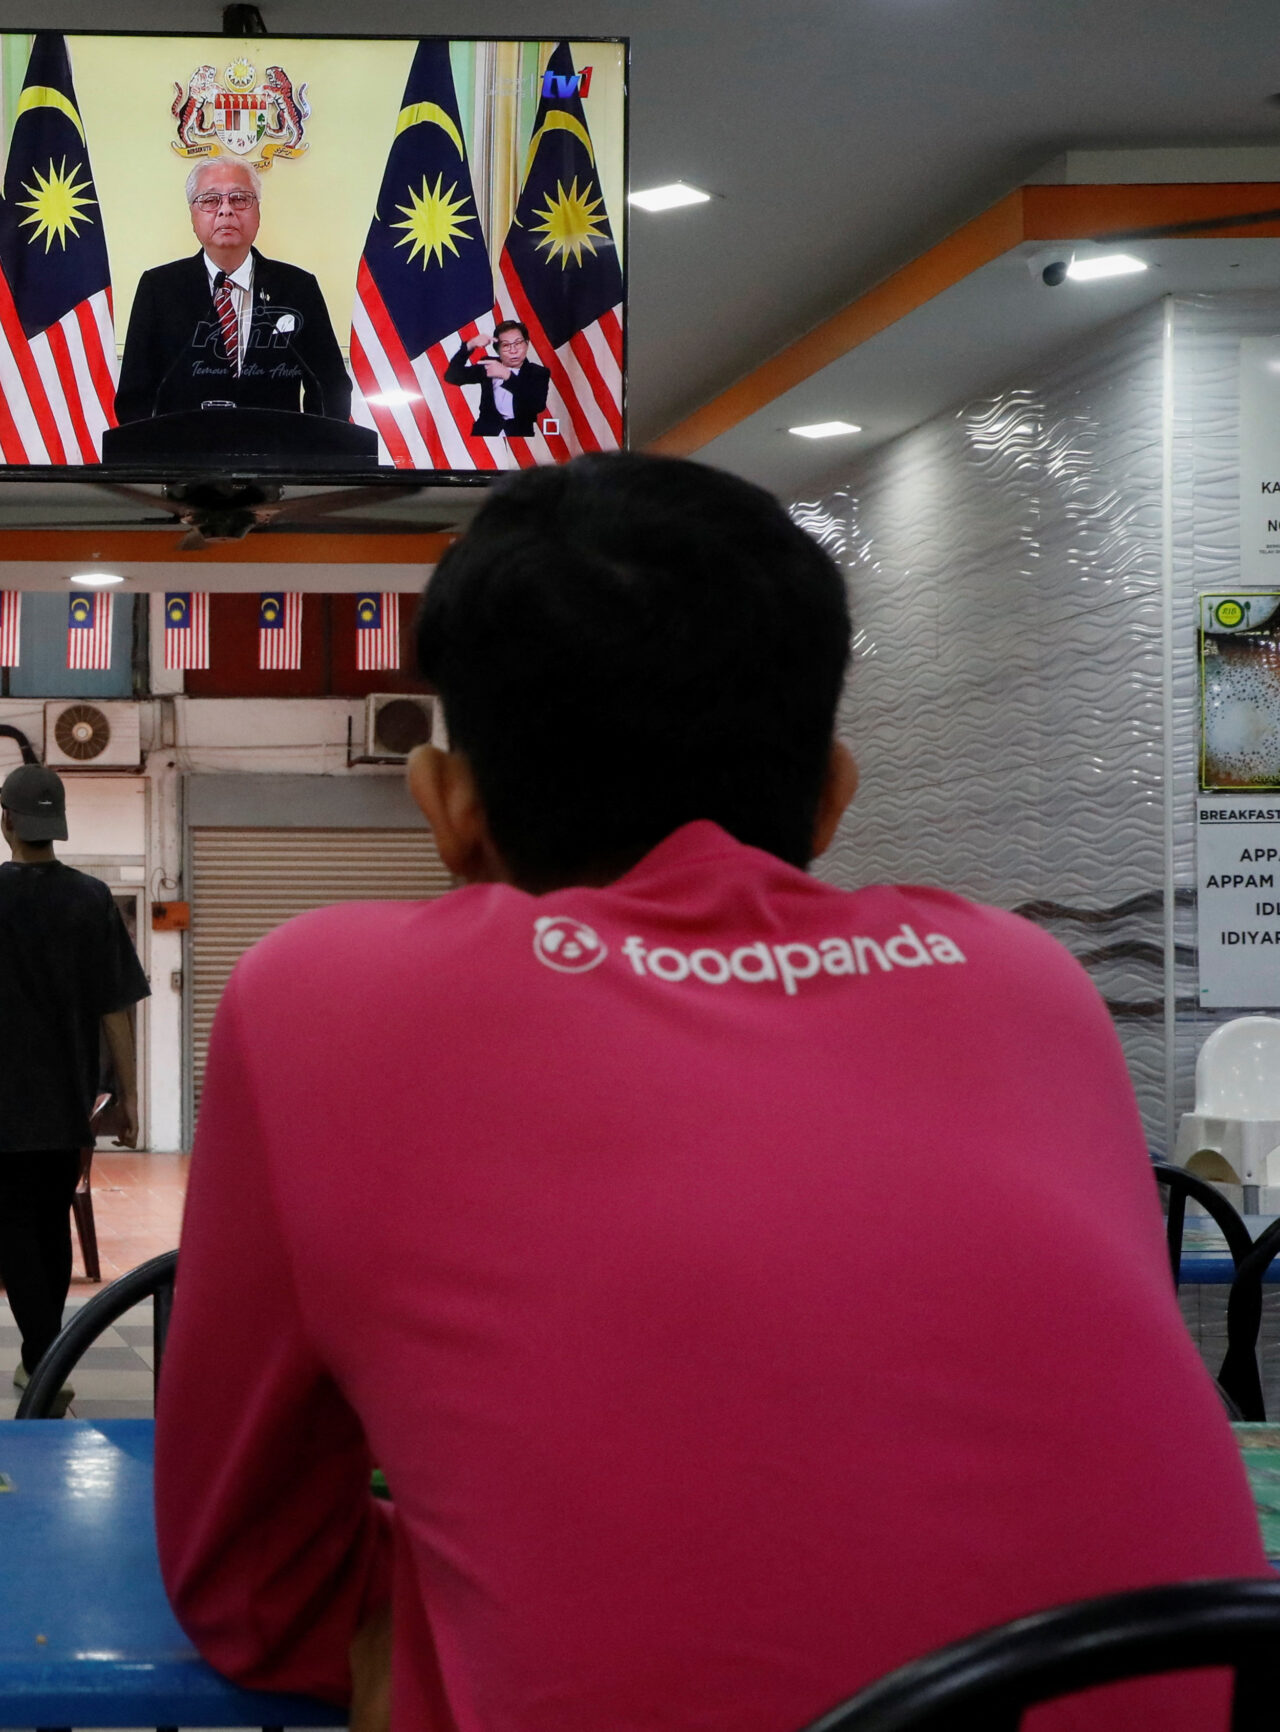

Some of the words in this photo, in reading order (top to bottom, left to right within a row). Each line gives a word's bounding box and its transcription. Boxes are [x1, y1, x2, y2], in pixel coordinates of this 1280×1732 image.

[540, 66, 593, 98] tv1
[192, 361, 227, 376] Teman
[1268, 520, 1280, 532] N
[1240, 848, 1280, 862] APP
[1206, 874, 1274, 888] APPAM
[621, 923, 968, 996] foodpanda
